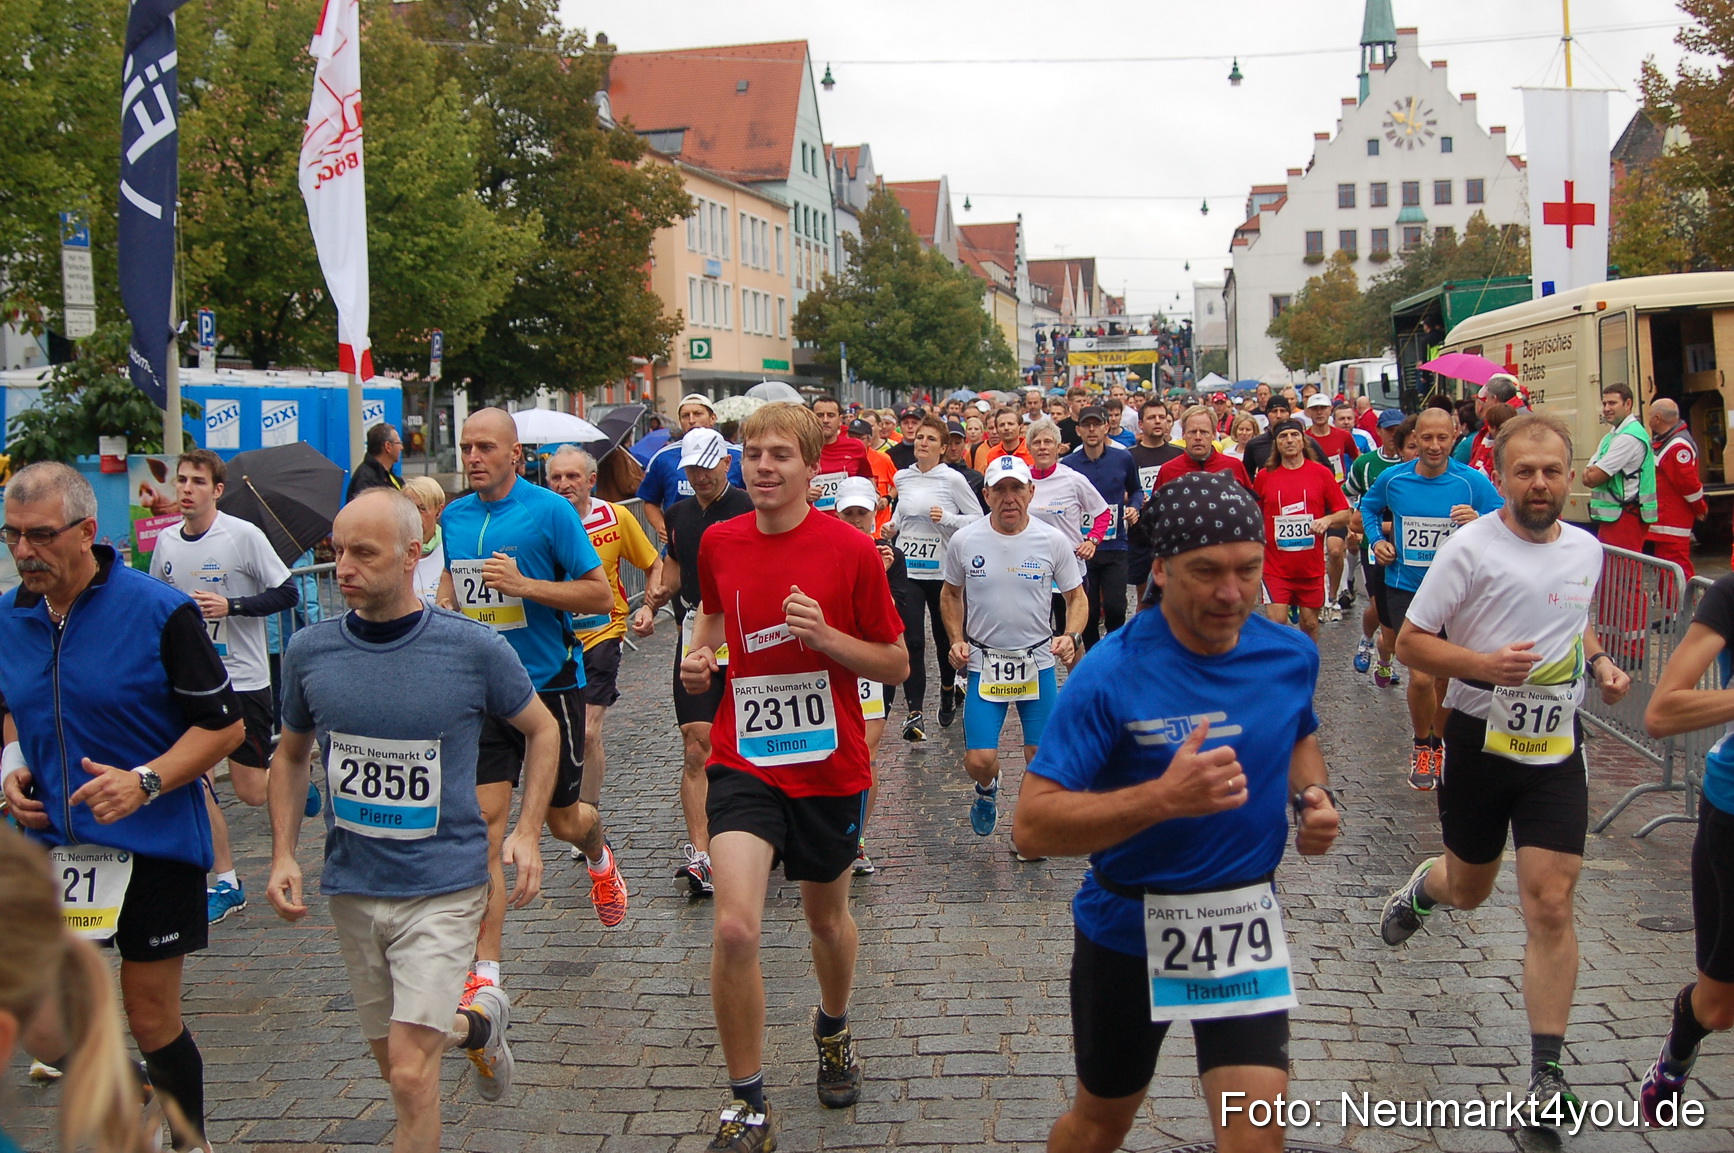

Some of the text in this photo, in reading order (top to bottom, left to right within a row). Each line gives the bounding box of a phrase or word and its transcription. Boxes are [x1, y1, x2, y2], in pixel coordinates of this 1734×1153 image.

[202, 315, 212, 343] P
[693, 340, 709, 357] D
[1522, 332, 1573, 361] Bayerisches
[1097, 353, 1129, 362] START
[1522, 363, 1546, 382] Rotes
[1279, 523, 1310, 538] 2330
[592, 531, 620, 547] ÖGL
[903, 542, 937, 558] 2247
[451, 567, 471, 575] PARTL
[478, 611, 496, 623] Juri
[758, 631, 781, 644] DEHN
[991, 662, 1026, 681] 191
[735, 682, 812, 696] PARTL Neumarkt
[990, 685, 1027, 695] Christoph
[1496, 687, 1526, 699] PARTL
[744, 693, 826, 733] 2310
[1507, 702, 1563, 734] 316
[333, 741, 421, 761] PARTL Neumarkt
[767, 739, 807, 753] Simon
[1509, 738, 1548, 753] Roland
[340, 758, 430, 802] 2856
[360, 807, 403, 825] Pierre
[68, 853, 114, 862] Neumarkt
[1148, 901, 1258, 921] PARTL Neumarkt
[160, 932, 180, 945] JAKO
[1161, 917, 1273, 972] 2479
[1186, 977, 1260, 1001] Hartmut
